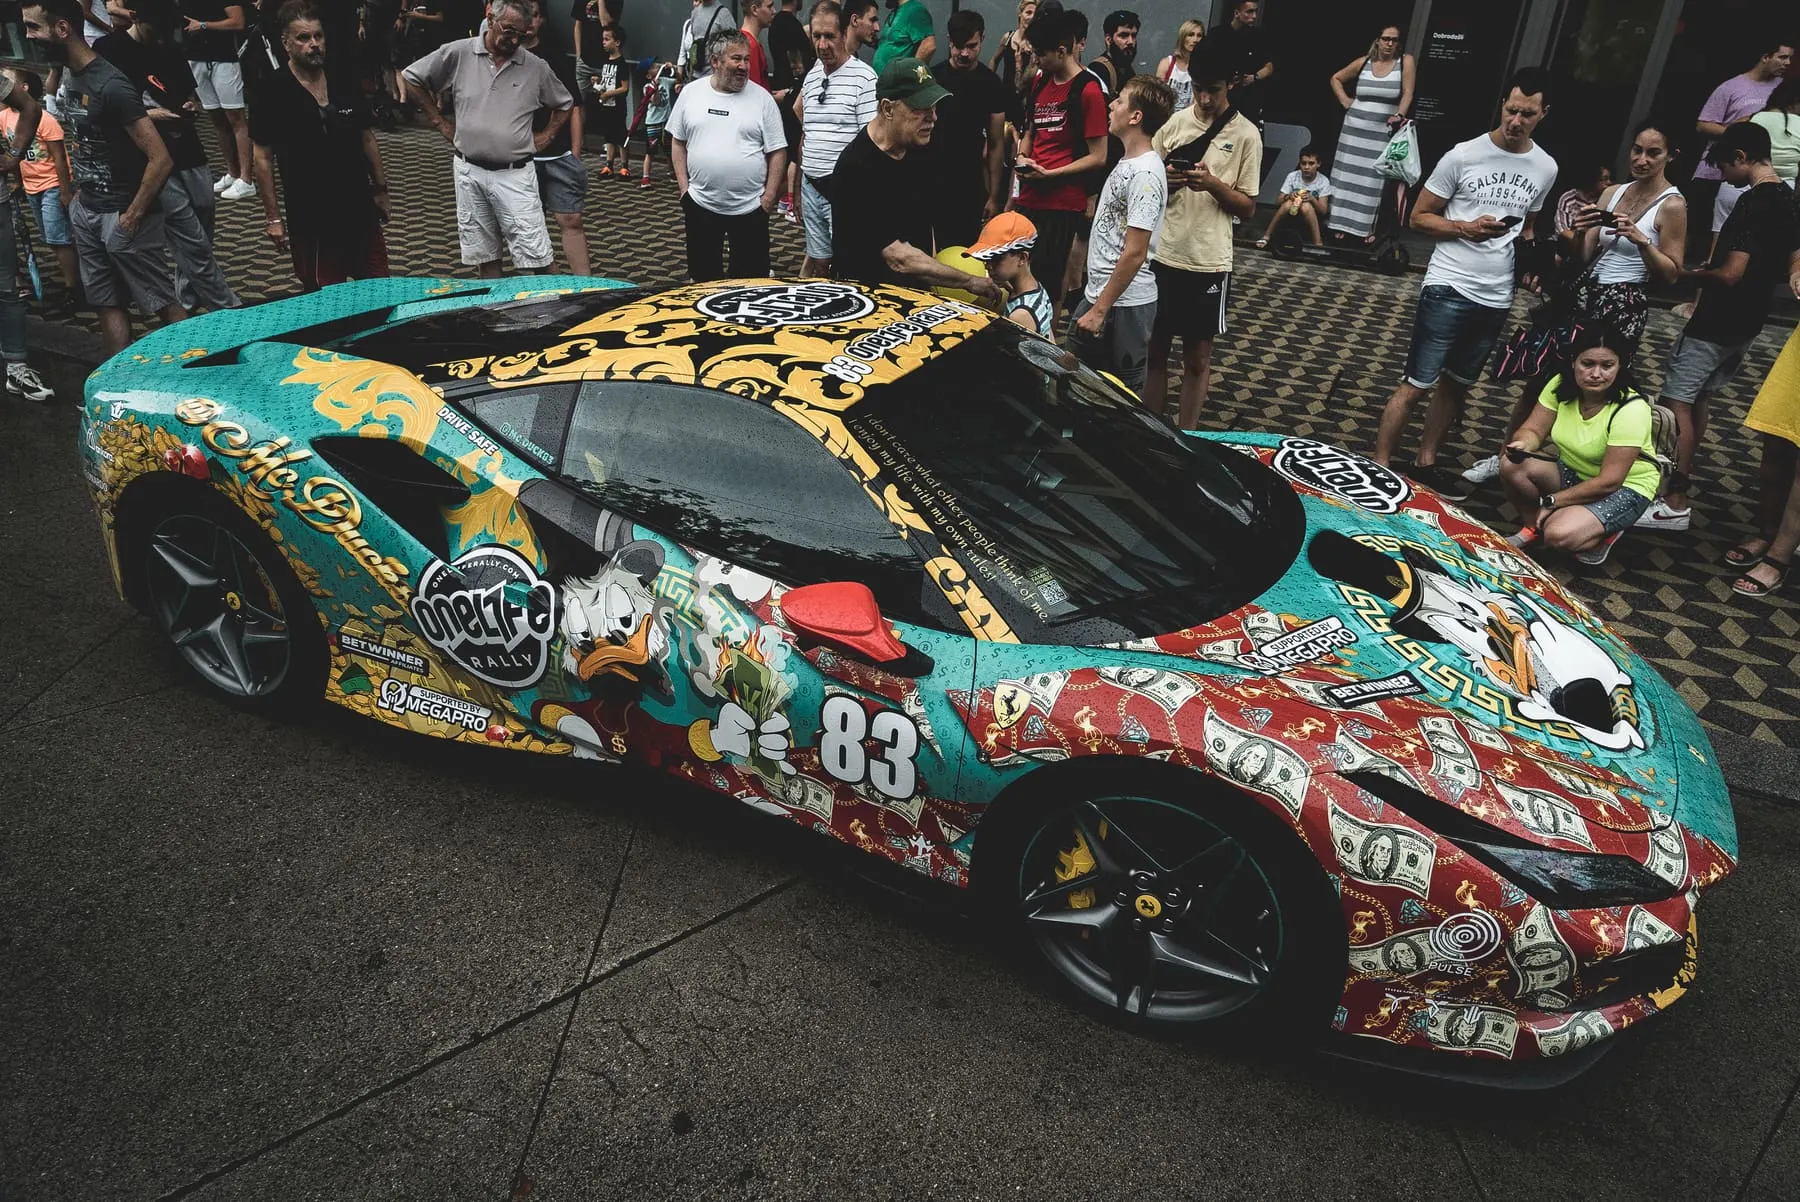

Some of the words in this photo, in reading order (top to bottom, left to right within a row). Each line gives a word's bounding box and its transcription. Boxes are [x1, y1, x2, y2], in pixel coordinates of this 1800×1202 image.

[1468, 172, 1506, 193] SALSA
[1509, 172, 1539, 200] JEANS
[1490, 187, 1517, 199] 1994
[822, 355, 873, 383] 83
[437, 407, 471, 435] DRIVE
[468, 430, 499, 456] SAFE
[853, 424, 881, 450] enjoy
[880, 450, 897, 466] my
[894, 464, 914, 482] life
[912, 483, 935, 507] with
[930, 507, 948, 525] my
[945, 525, 968, 549] own
[966, 549, 998, 583] rules!
[892, 440, 917, 463] care
[915, 463, 942, 488] what
[937, 489, 964, 519] other
[959, 518, 997, 556] people
[994, 555, 1024, 588] think
[1020, 588, 1039, 601] of
[1031, 602, 1048, 622] me.
[432, 559, 520, 589] ONELFERALLY.COM
[1270, 625, 1321, 652] SUPPORTED
[1320, 621, 1331, 633] BY
[341, 634, 424, 668] BETWINNER
[470, 653, 533, 669] RALLY
[390, 658, 424, 674] AFFILIATES
[1331, 675, 1414, 699] BETWINNER
[420, 690, 469, 712] SUPPORTED
[470, 705, 481, 714] BY
[820, 695, 918, 799] 83
[1411, 875, 1426, 887] 100
[1428, 962, 1474, 977] PULSE
